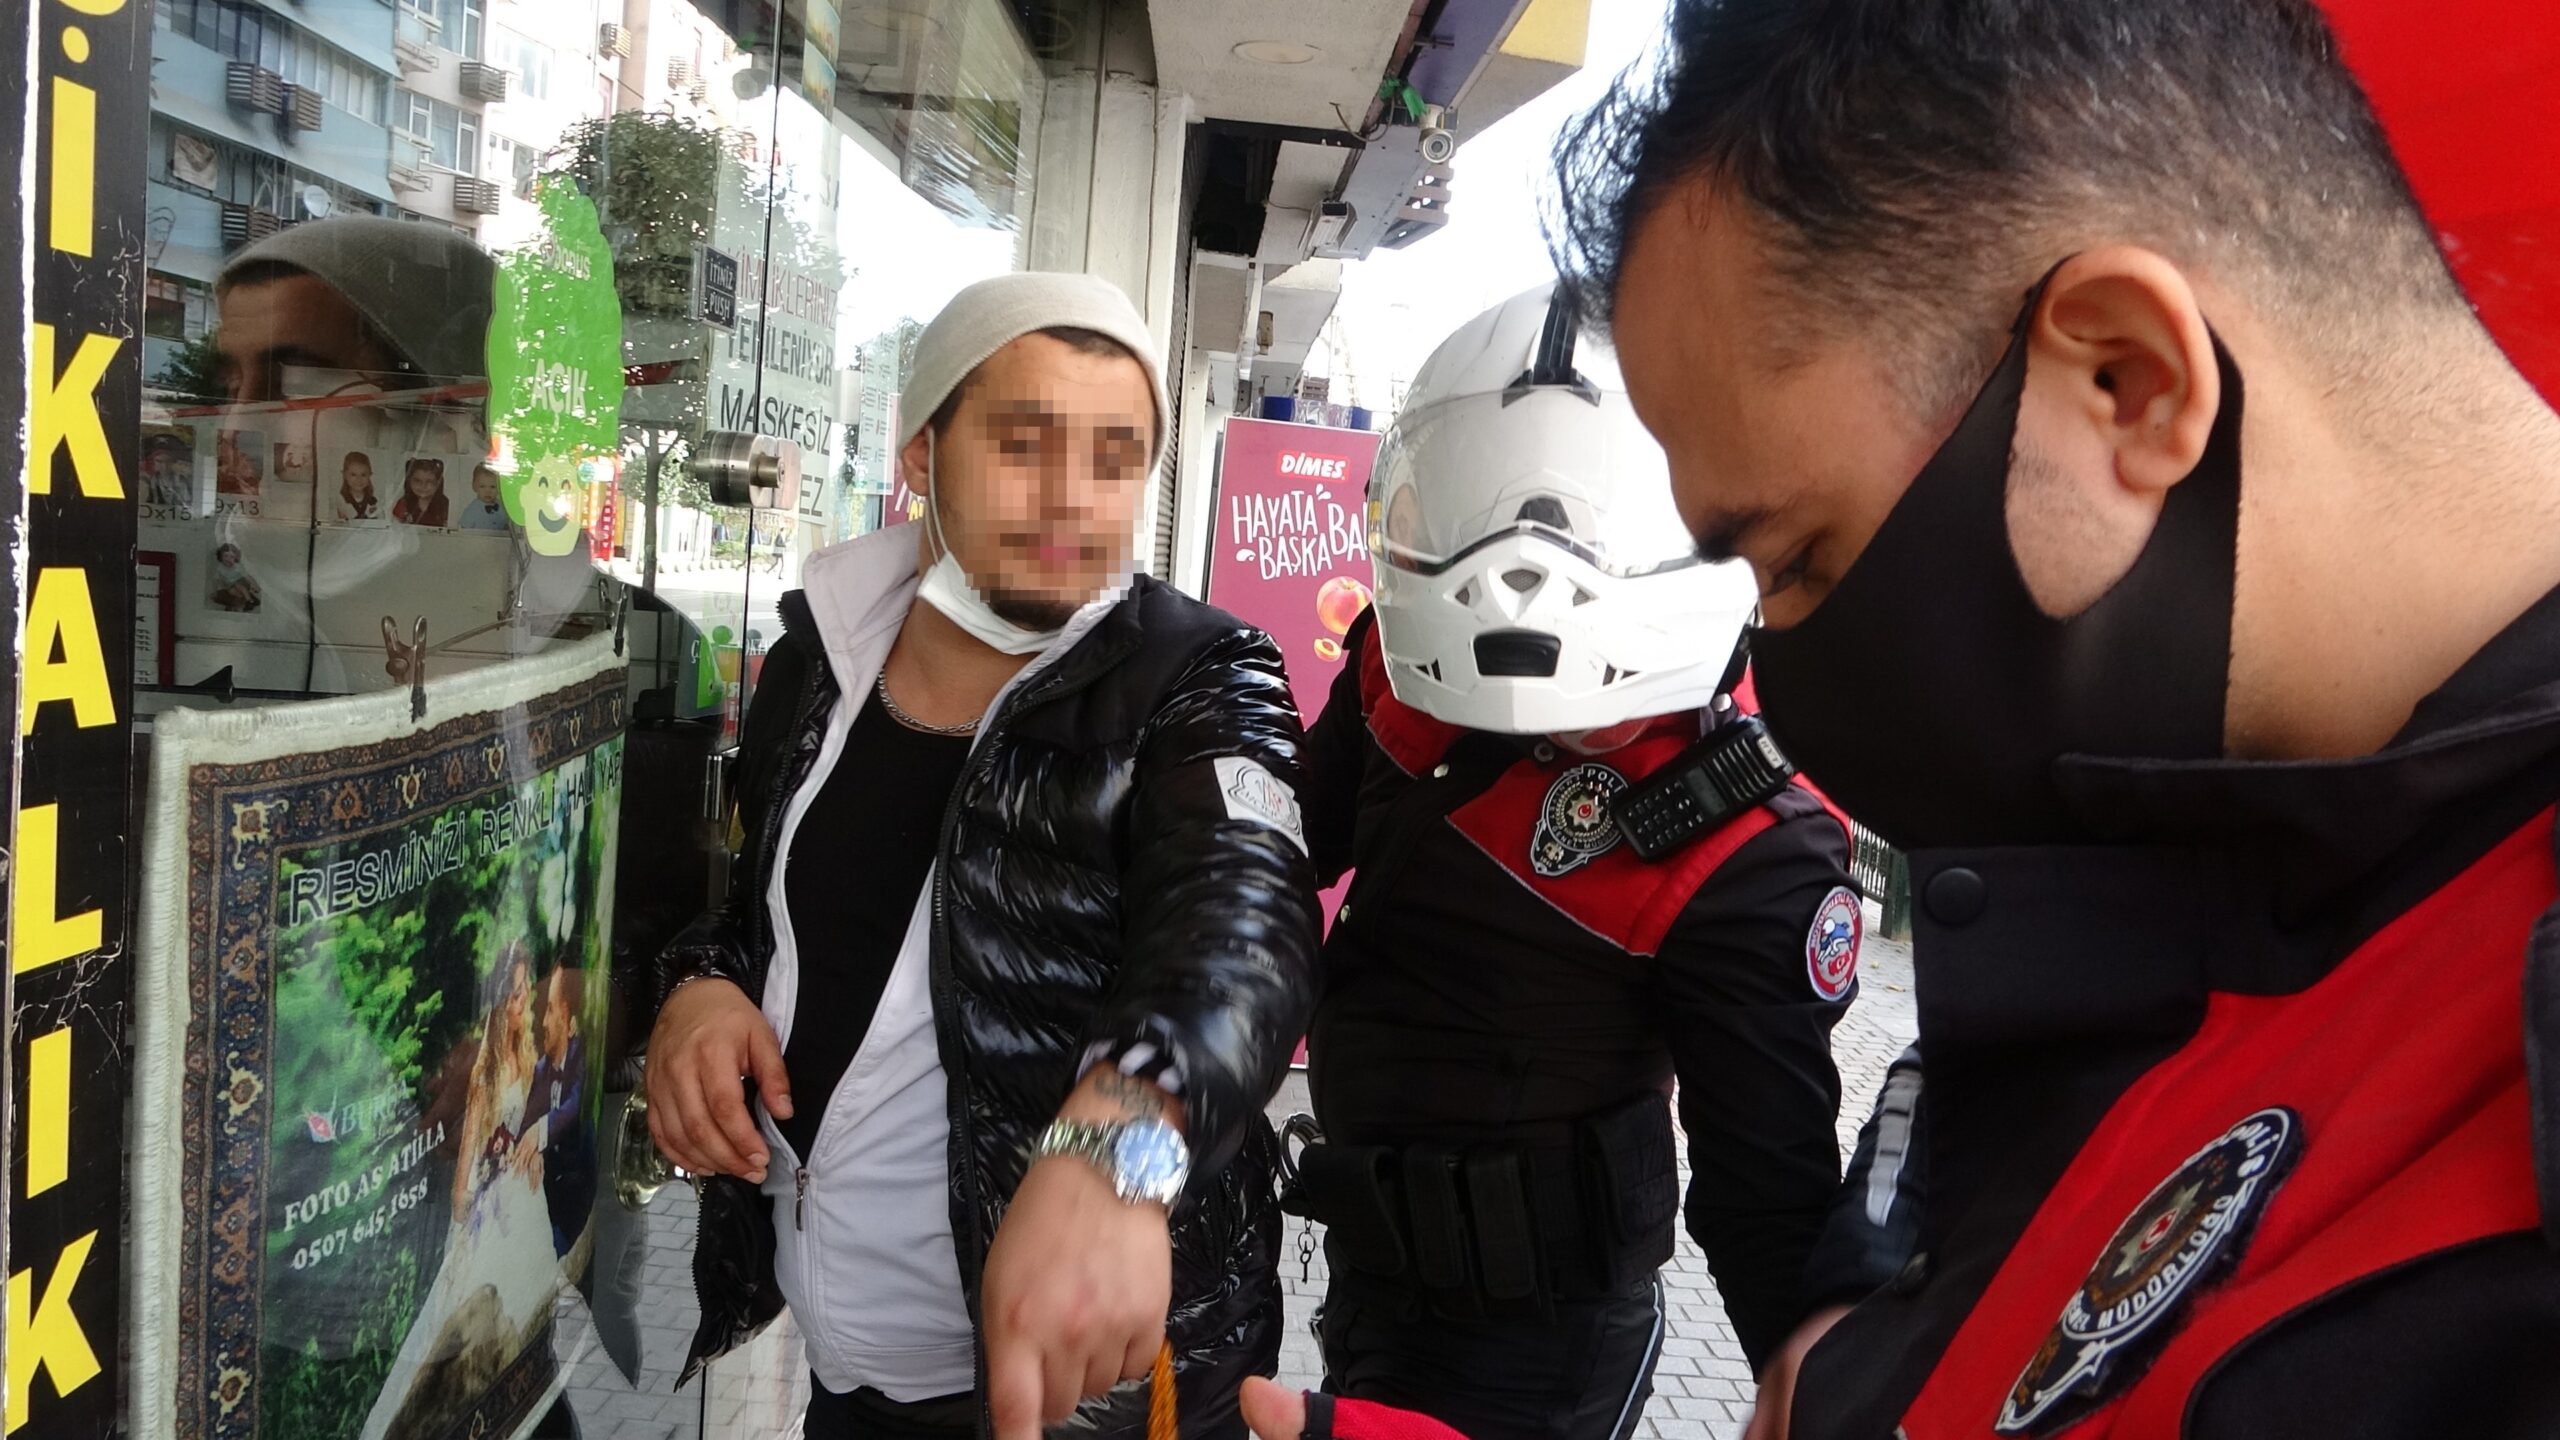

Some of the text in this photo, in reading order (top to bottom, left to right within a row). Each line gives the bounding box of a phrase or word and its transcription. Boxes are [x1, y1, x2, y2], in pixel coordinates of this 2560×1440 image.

[709, 290, 731, 319] PUSH
[531, 358, 588, 433] AÇIK
[720, 384, 832, 457] MASKESİZ
[1281, 453, 1347, 479] DİMES
[215, 499, 260, 516] 9x13
[1232, 491, 1318, 544] HAYATA
[1258, 533, 1333, 580] BAŞKA
[5, 0, 127, 1437] İKALIK
[289, 811, 466, 927] RESMİNİZİ
[480, 778, 557, 857] RENKLİ
[599, 748, 622, 794] YAP
[284, 1180, 350, 1232] FOTO
[355, 1165, 384, 1203] AS
[387, 1120, 446, 1179] ATİLLA
[292, 1177, 428, 1270] 0507 645 1658
